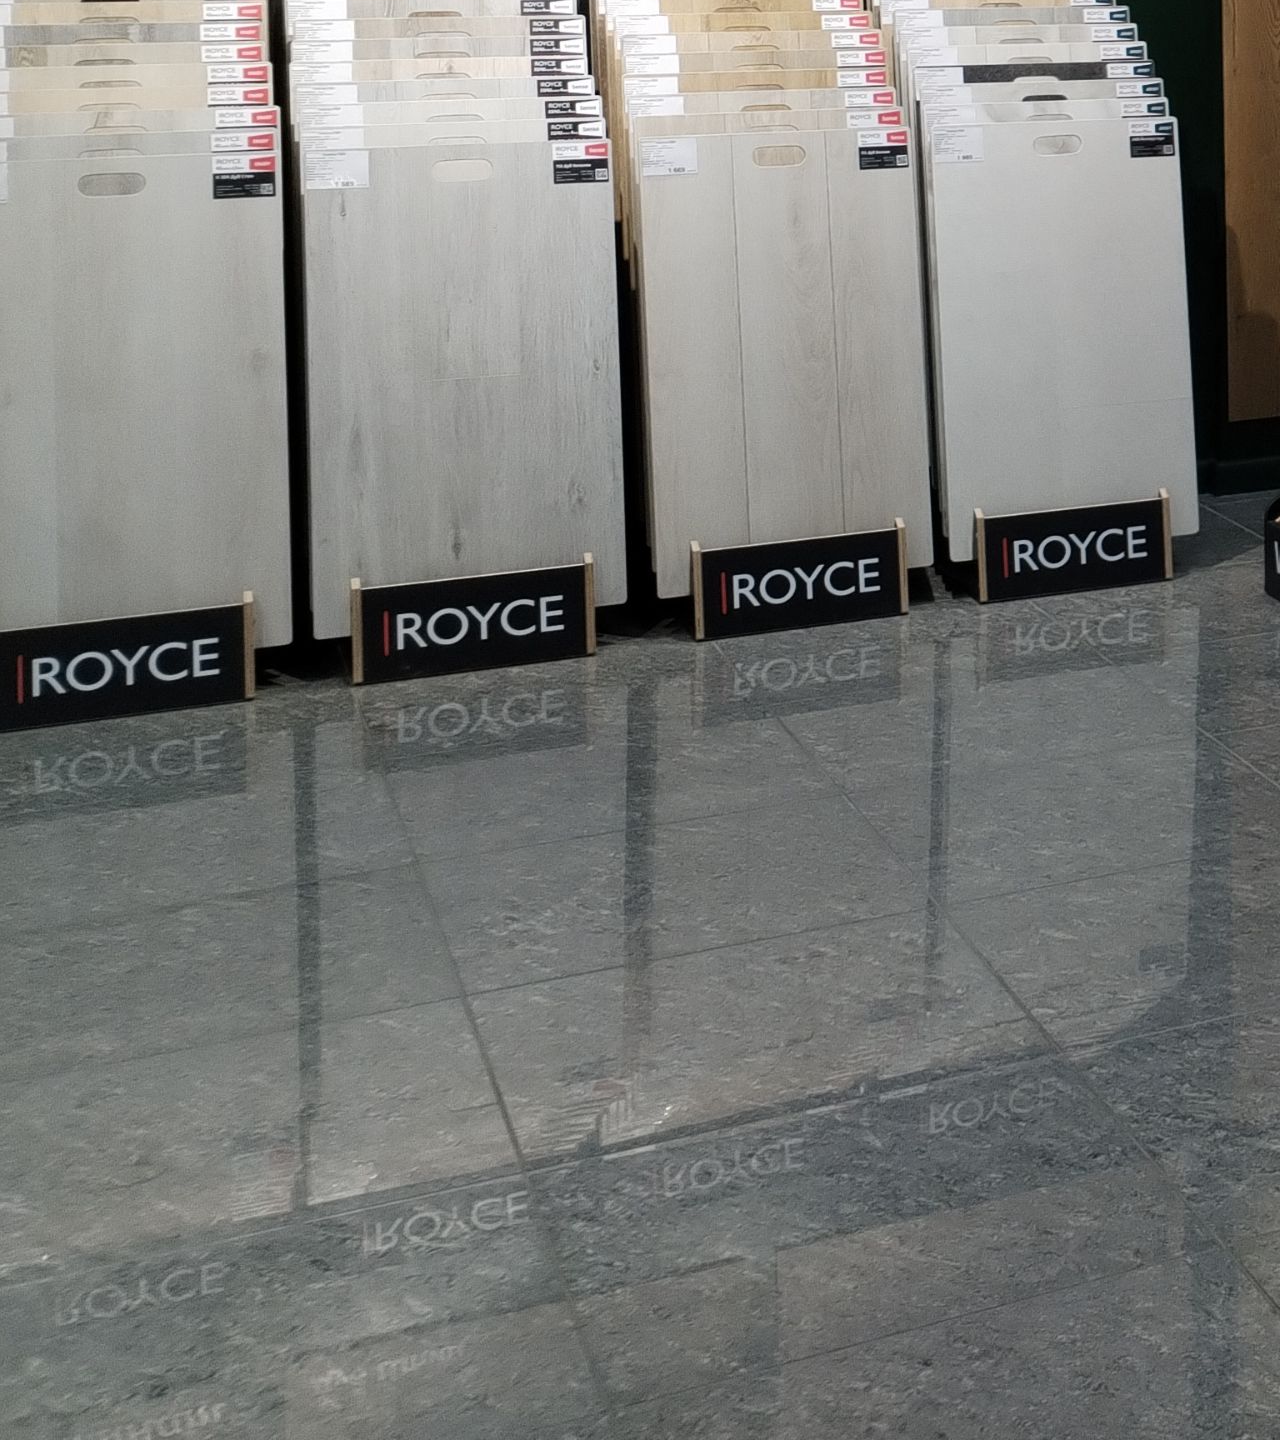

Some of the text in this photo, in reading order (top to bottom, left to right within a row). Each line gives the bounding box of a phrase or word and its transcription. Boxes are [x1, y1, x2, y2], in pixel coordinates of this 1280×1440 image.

[1012, 525, 1149, 574] ROYCE
[732, 557, 882, 611] ROYCE
[395, 594, 566, 651] ROYCE
[31, 637, 221, 698] ROYCE
